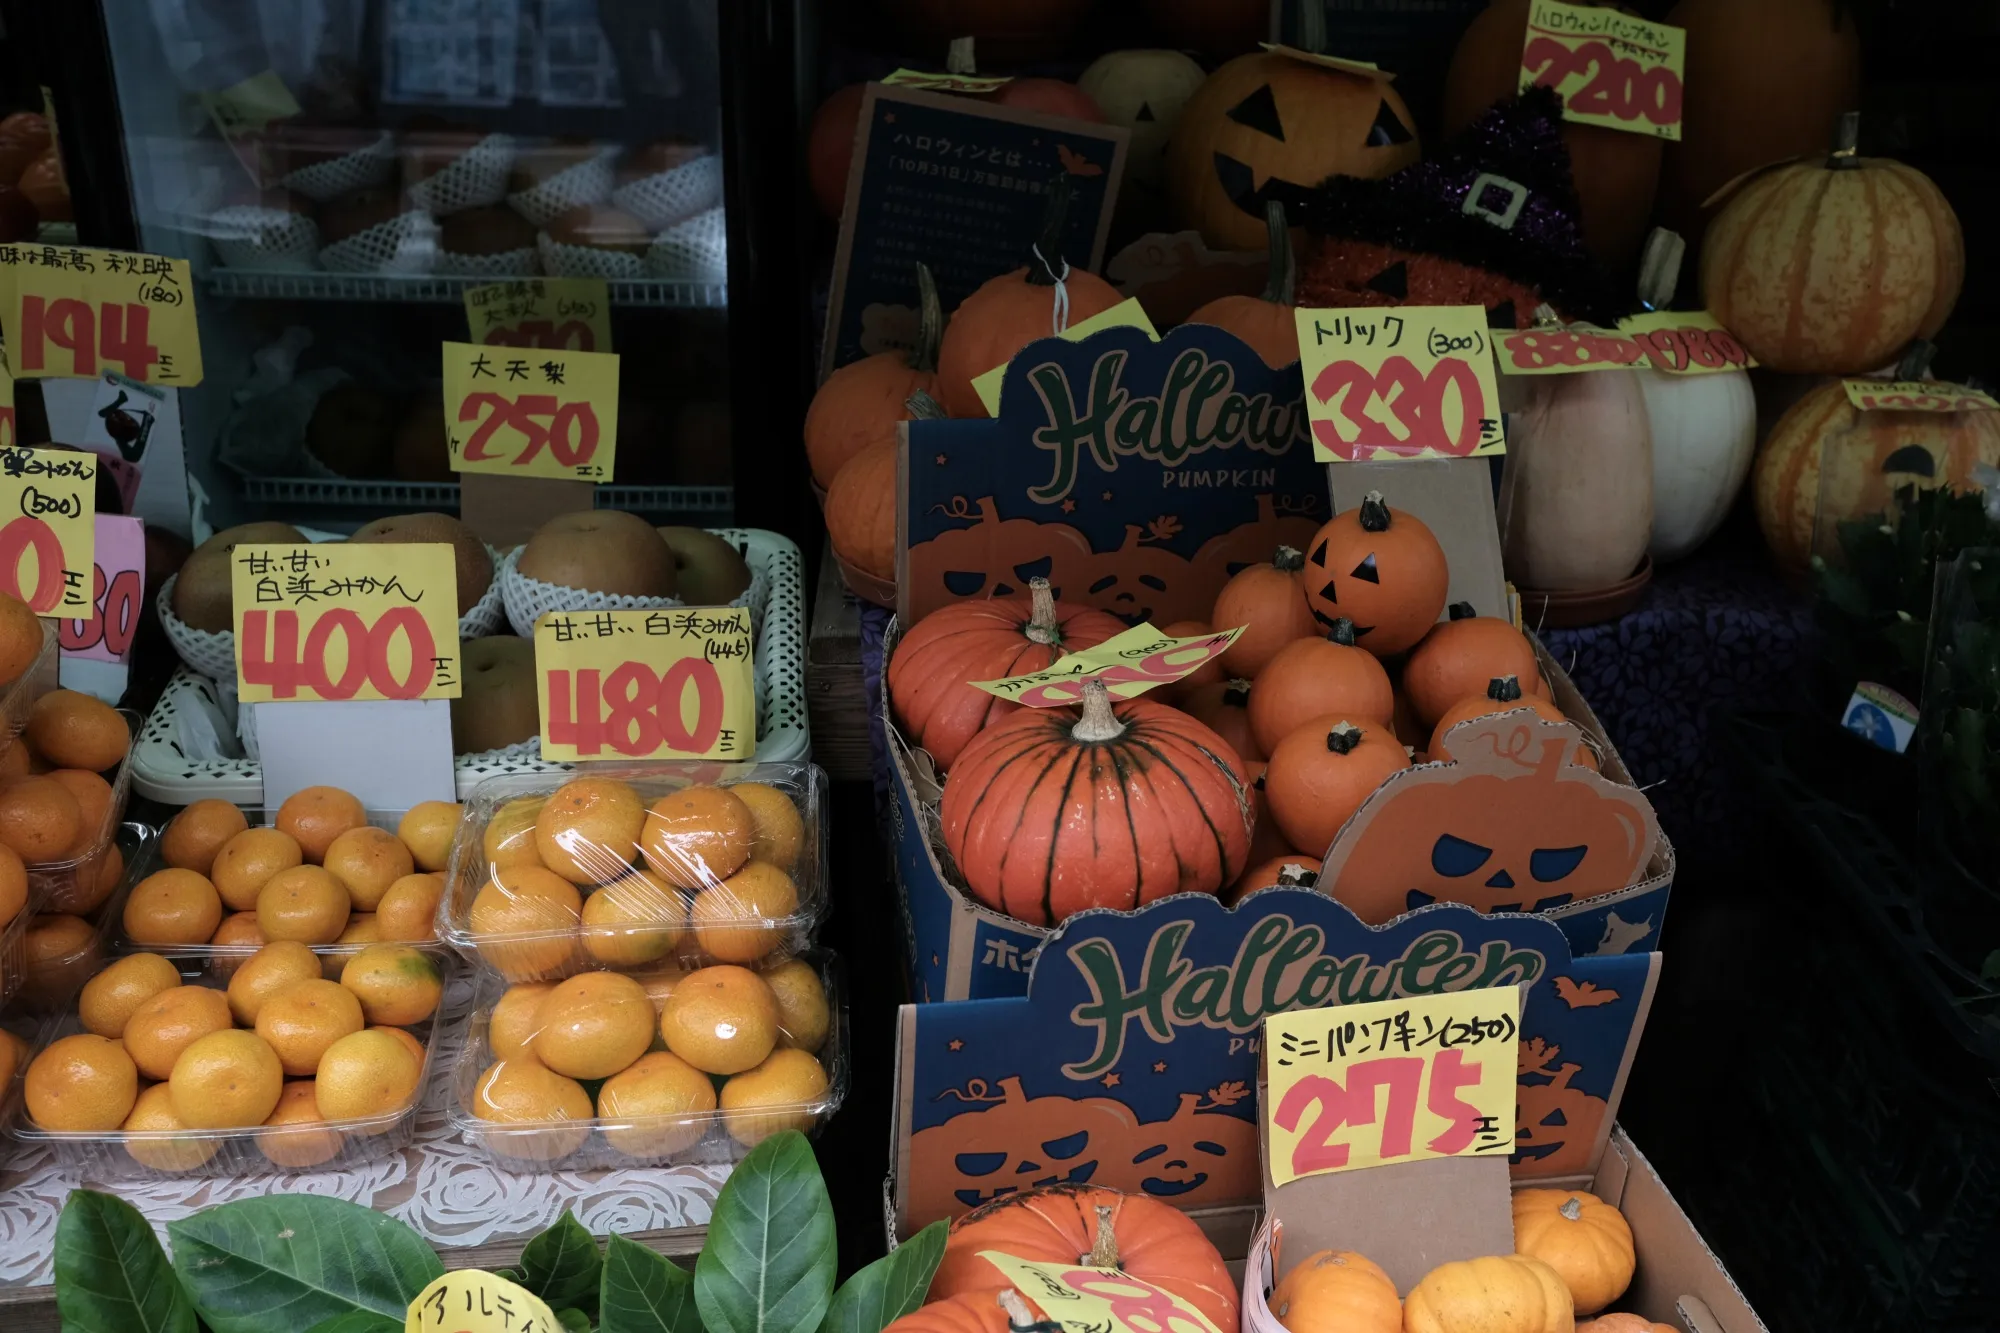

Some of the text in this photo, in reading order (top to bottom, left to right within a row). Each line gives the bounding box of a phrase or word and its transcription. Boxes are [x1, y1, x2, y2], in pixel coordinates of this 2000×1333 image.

[1524, 37, 1683, 124] 2200
[138, 282, 183, 307] (180)
[21, 295, 158, 382] 194
[1314, 316, 1485, 358] トリック (300)
[1632, 327, 1748, 371] 1980
[458, 392, 600, 467] 250
[1310, 355, 1485, 461] 330
[20, 486, 82, 519] (500)
[1162, 466, 1276, 489] PUMPKIN
[255, 573, 423, 604] 白浜みかん
[241, 606, 437, 701] 400
[645, 611, 750, 639] 白浜みかん
[703, 638, 750, 664] (445)
[547, 656, 724, 757] 480
[1060, 913, 1547, 1082] Halloween
[1273, 1048, 1482, 1177] 275
